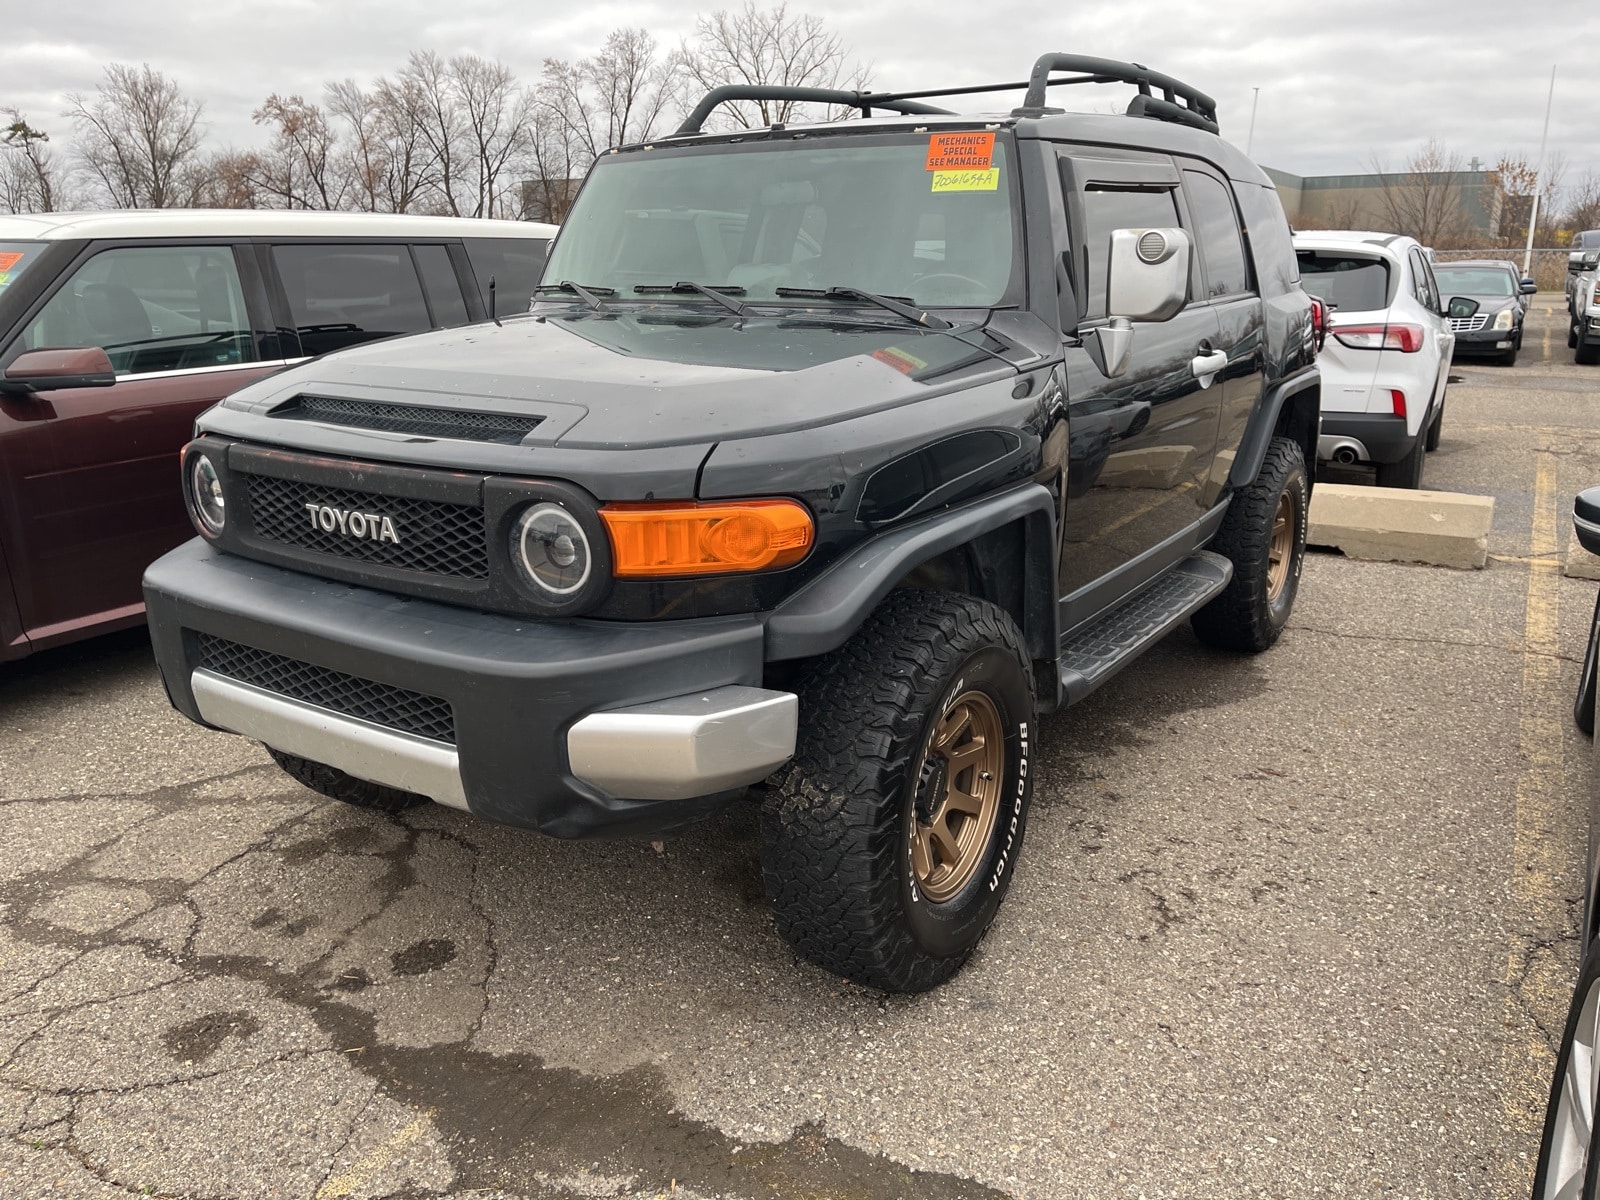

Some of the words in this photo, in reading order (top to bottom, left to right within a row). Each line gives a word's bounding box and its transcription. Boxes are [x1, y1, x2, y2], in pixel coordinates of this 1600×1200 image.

[938, 136, 986, 146] MECHANICS
[943, 147, 977, 156] SPECIAL
[929, 158, 944, 166] SEE
[946, 157, 989, 165] MANAGER
[305, 503, 399, 543] TOYOTA
